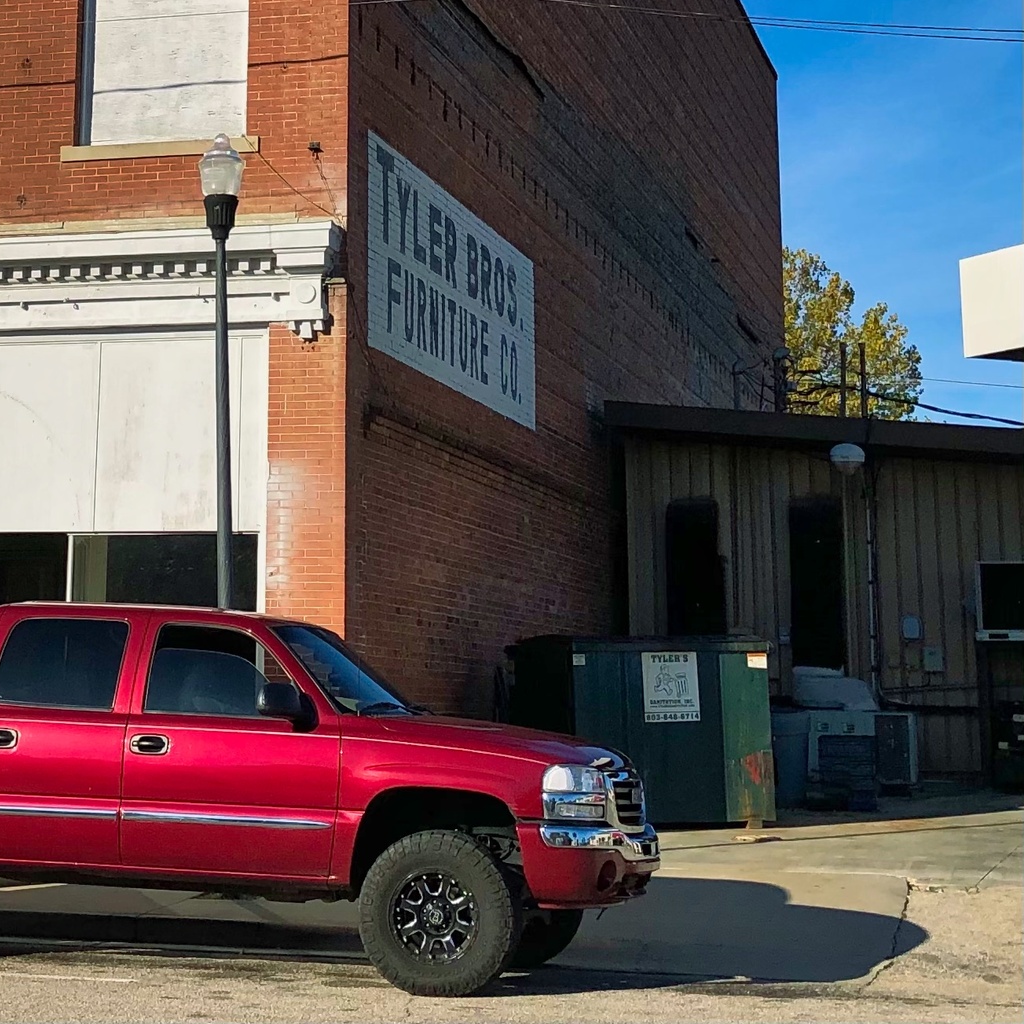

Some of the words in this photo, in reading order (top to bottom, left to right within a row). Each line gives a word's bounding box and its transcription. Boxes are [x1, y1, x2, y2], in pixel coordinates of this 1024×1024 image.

[376, 143, 457, 290] TYLER
[466, 232, 524, 332] BROS.
[387, 256, 489, 386] FURNITURE
[499, 333, 522, 405] CO.
[650, 654, 688, 663] TYLER'S
